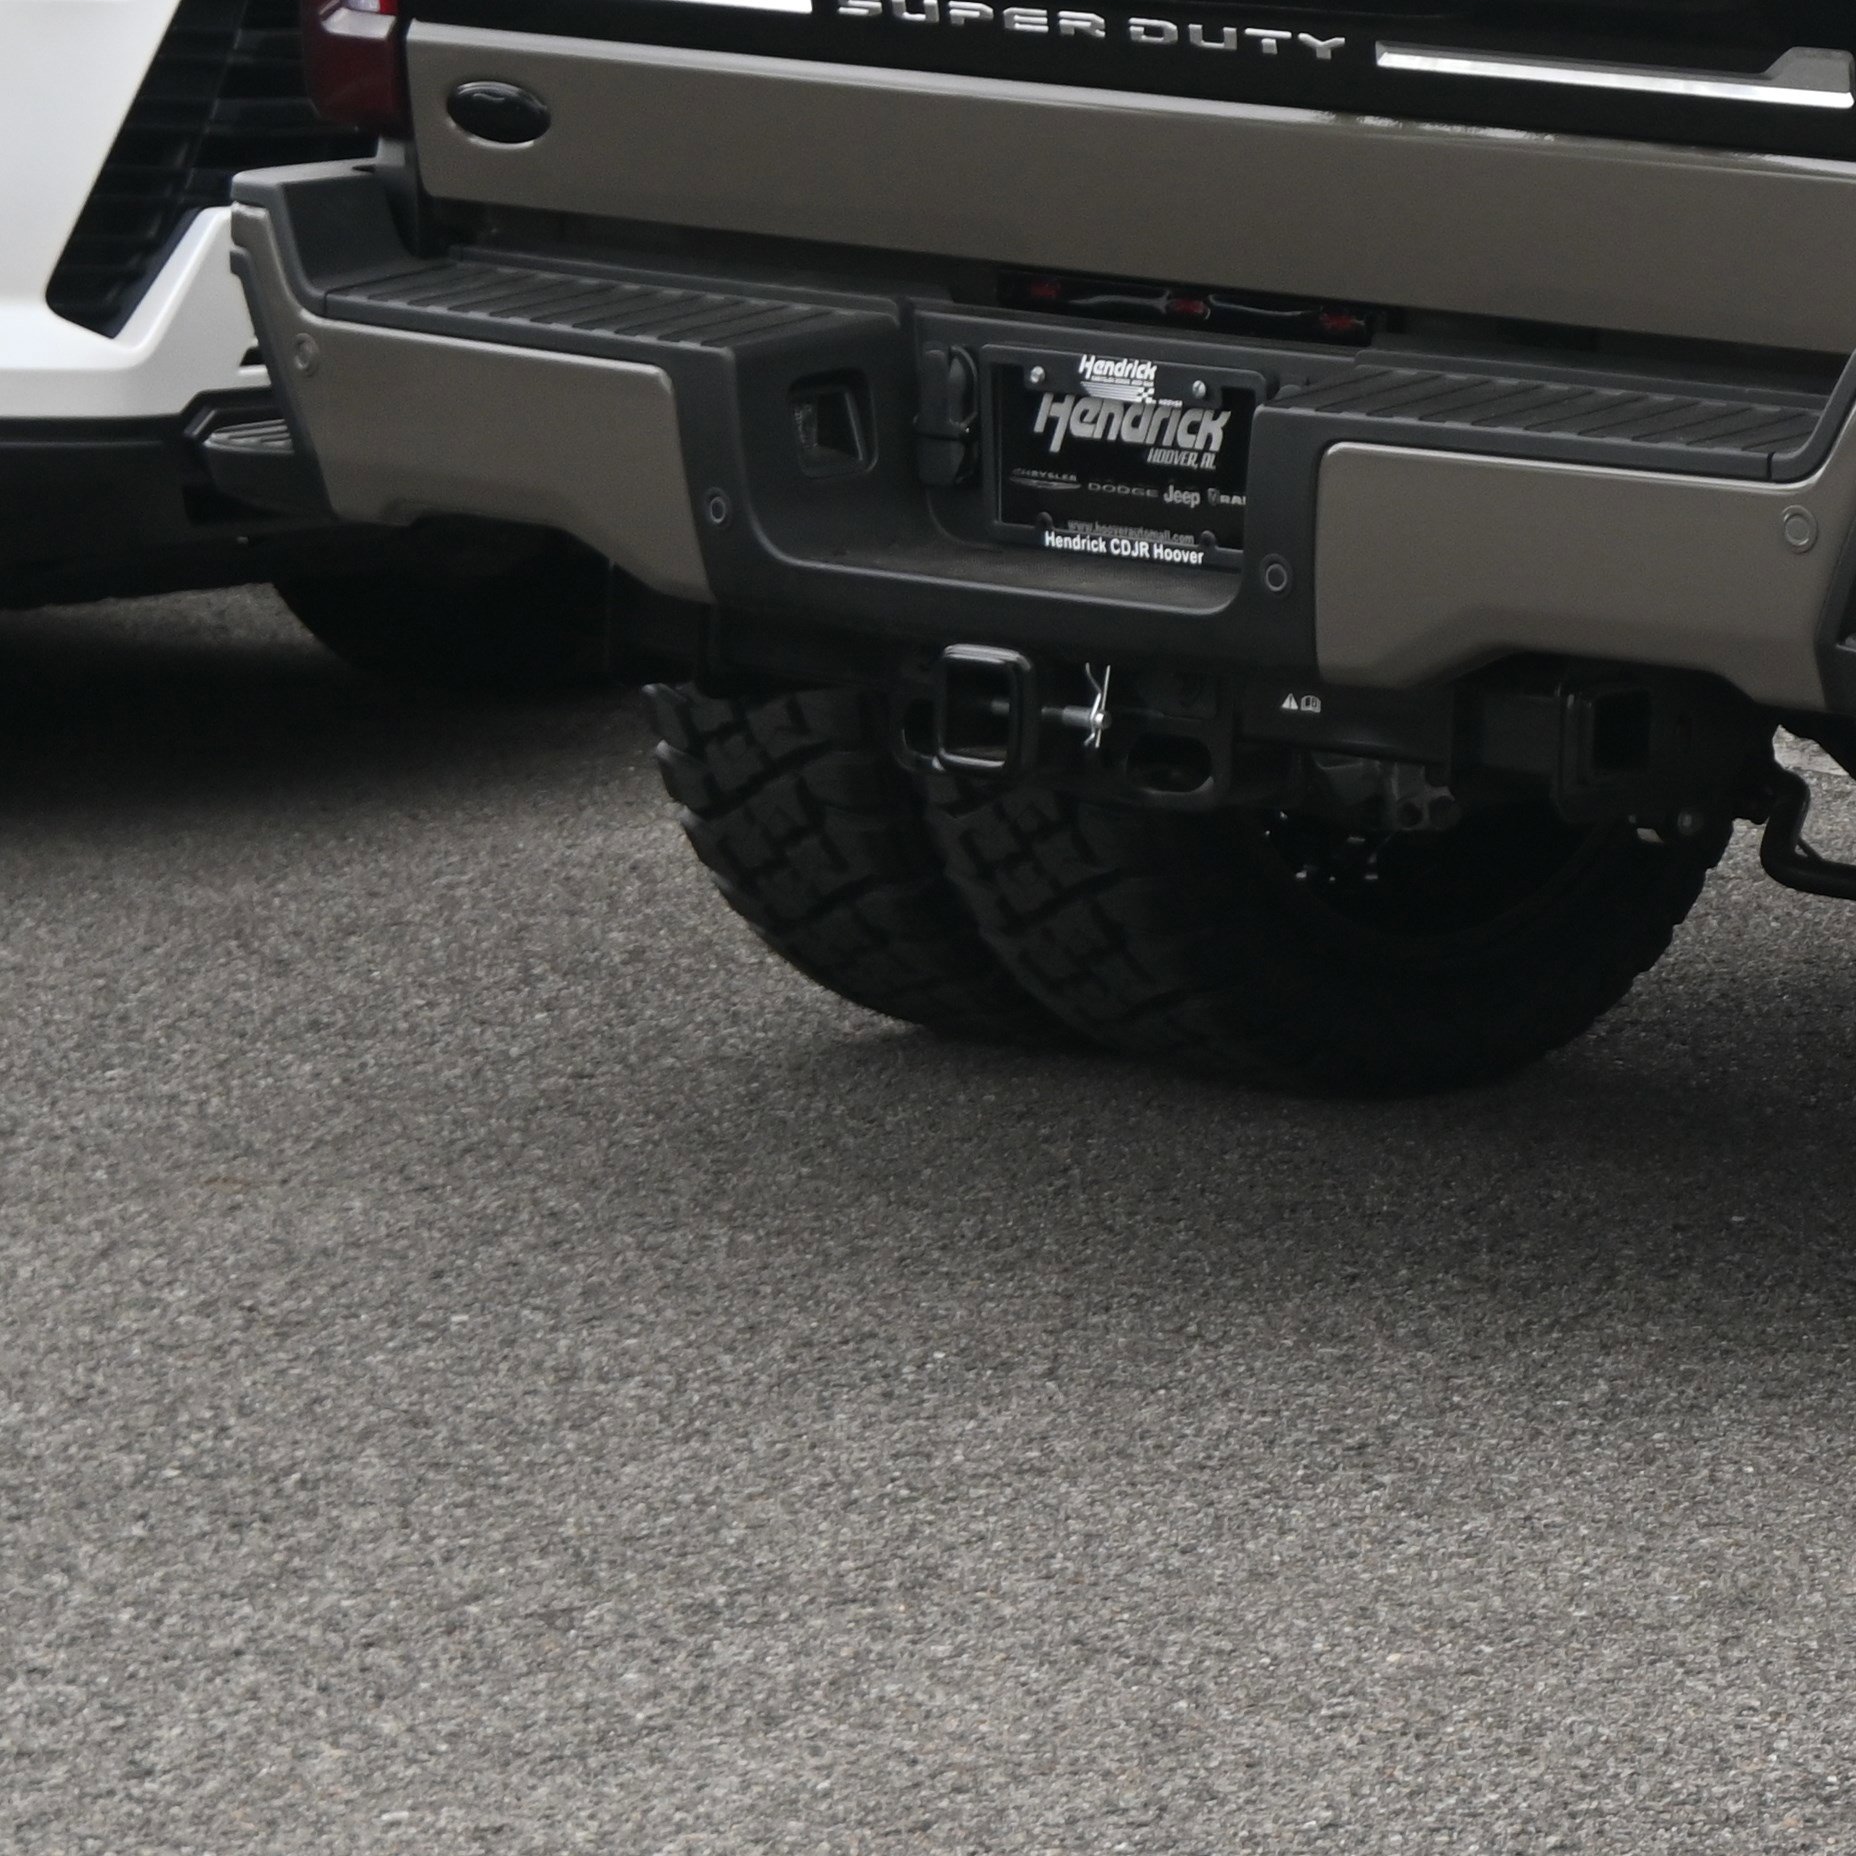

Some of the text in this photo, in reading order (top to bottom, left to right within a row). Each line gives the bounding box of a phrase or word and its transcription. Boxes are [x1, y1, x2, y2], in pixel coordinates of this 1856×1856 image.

[1127, 16, 1346, 60] DUTY
[1078, 354, 1158, 380] Hendrick
[1033, 392, 1232, 453] Hendrick
[1147, 447, 1198, 470] HOOVER,
[1012, 467, 1077, 482] CHRYSLER
[1087, 481, 1159, 498] DODGE
[1163, 485, 1201, 508] Jeep
[1043, 530, 1205, 565] Hendrick CDJR Hoover
